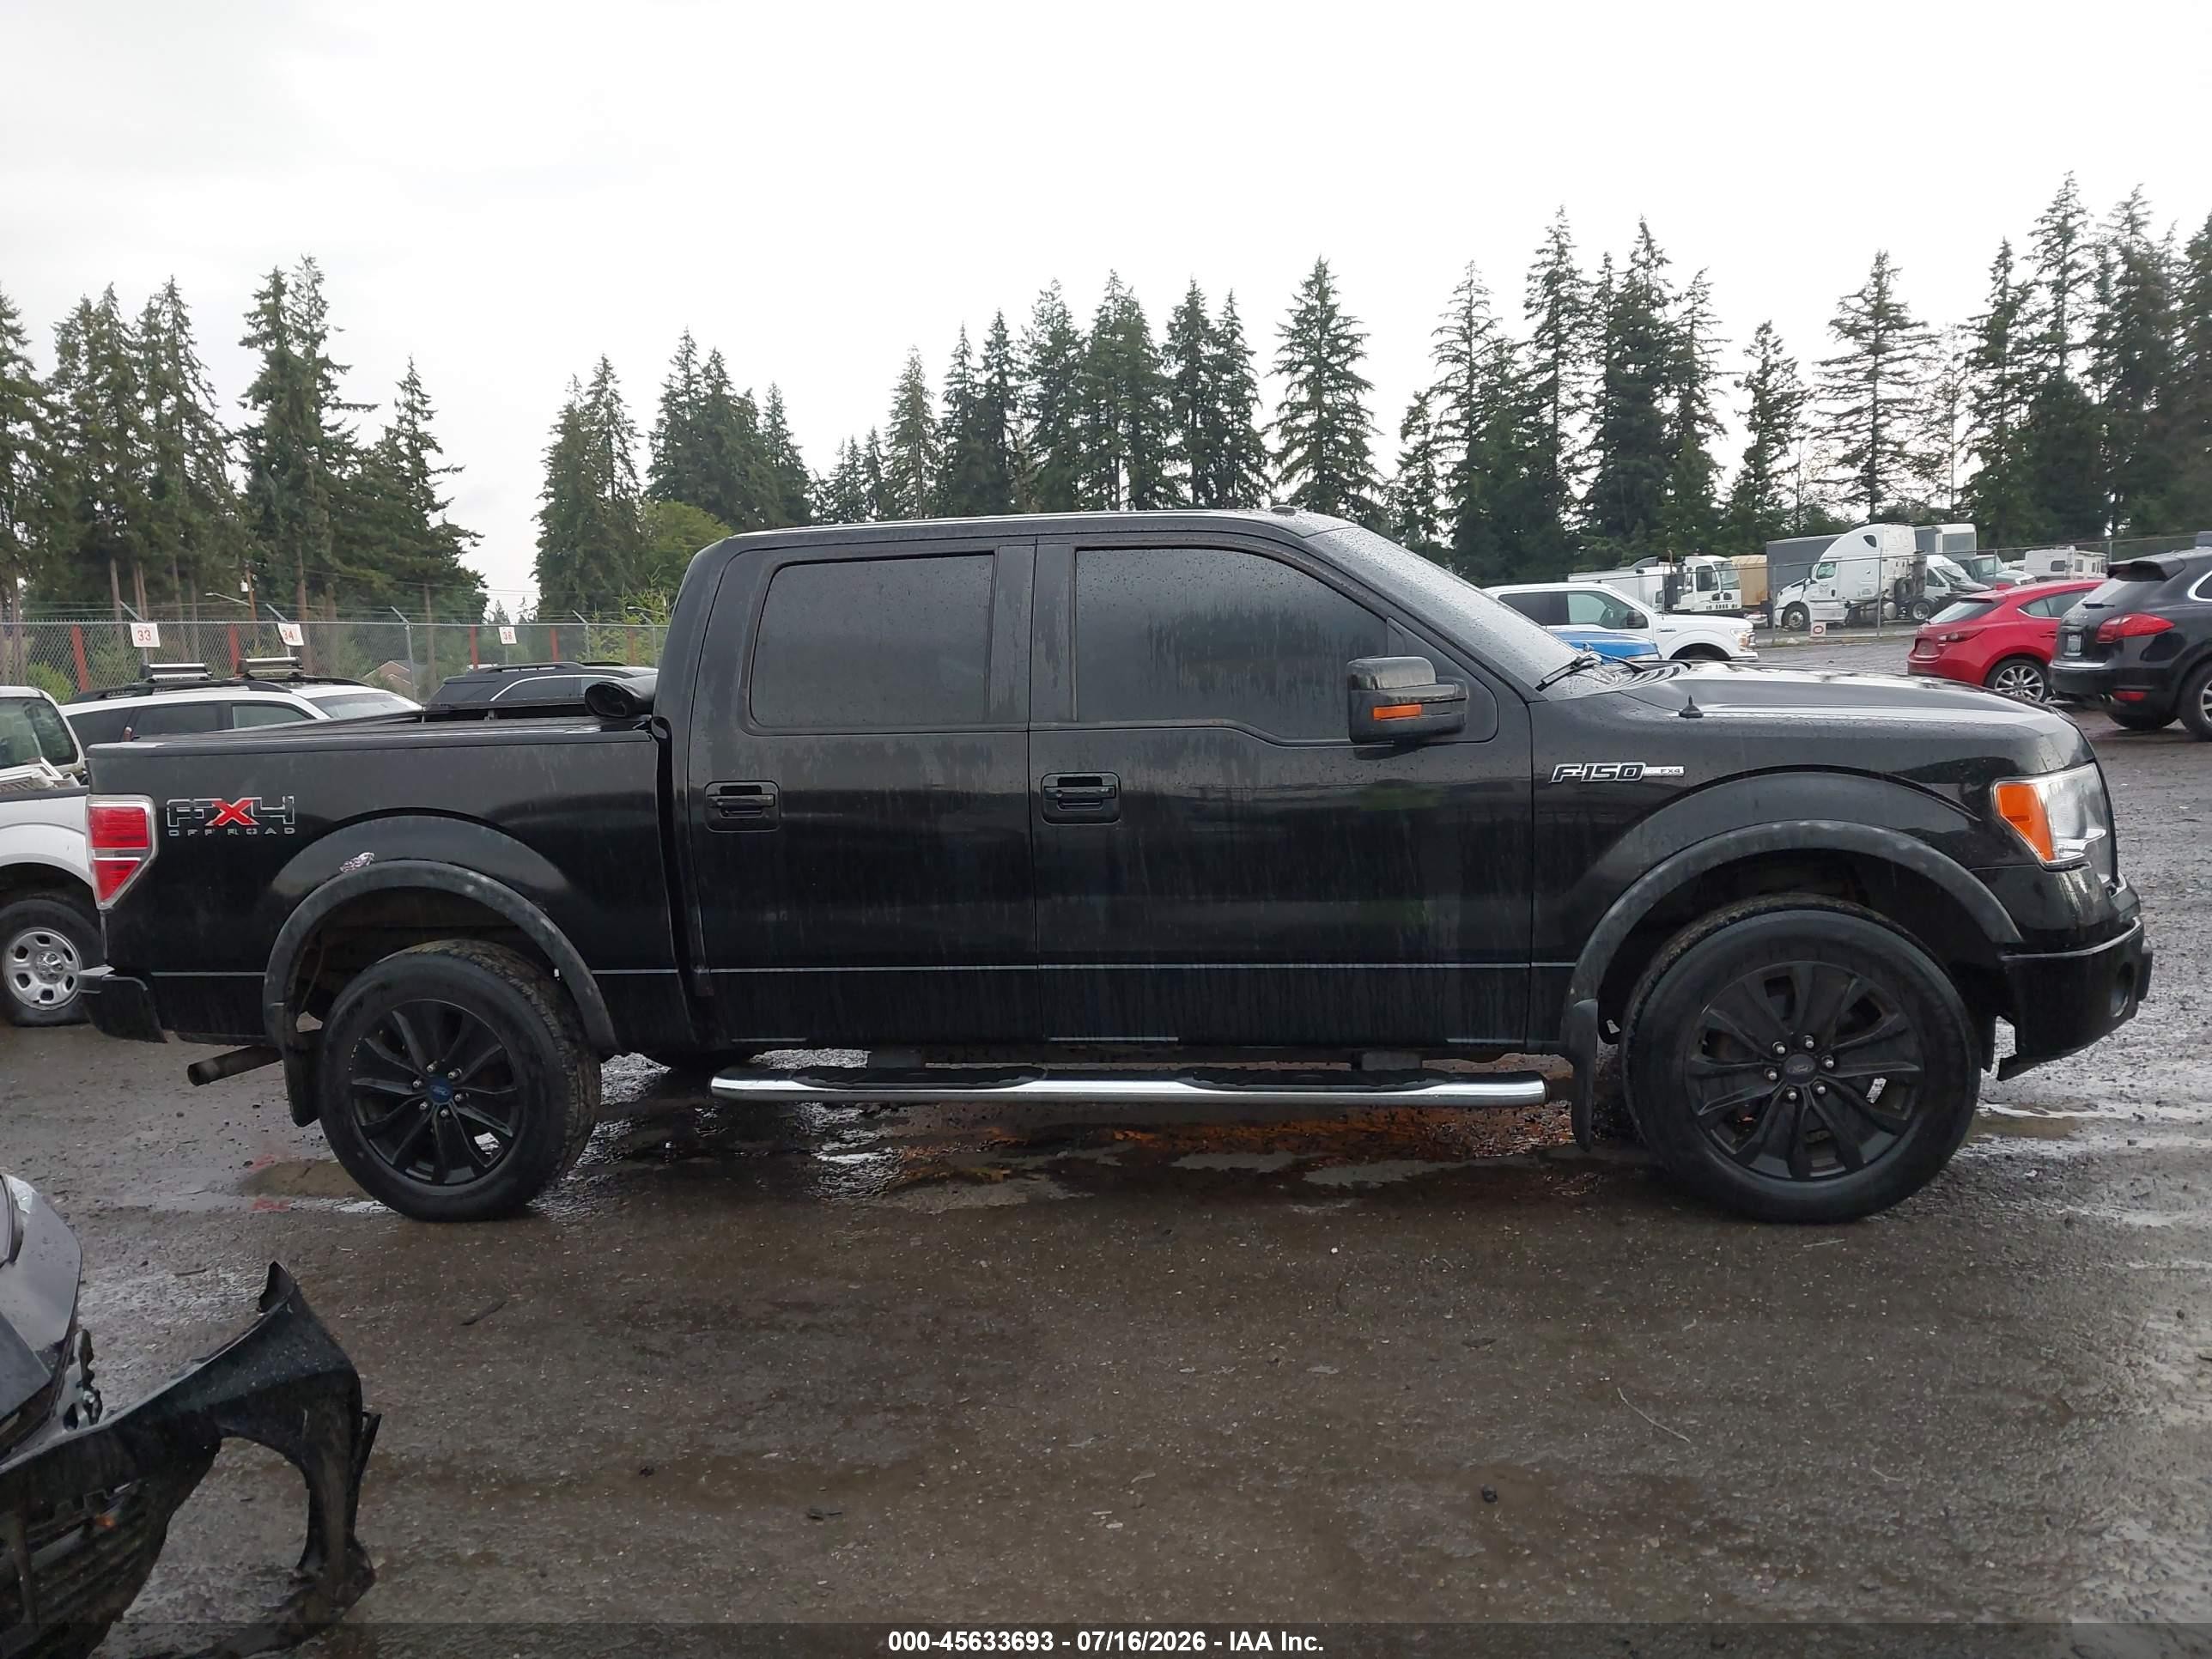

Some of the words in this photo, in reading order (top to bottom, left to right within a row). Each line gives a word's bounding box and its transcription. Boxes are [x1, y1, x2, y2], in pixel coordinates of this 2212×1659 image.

[137, 629, 152, 641] 33
[282, 629, 295, 641] 34
[1550, 762, 1647, 783] F-150
[166, 795, 295, 828] FX4
[167, 829, 216, 837] OFF
[227, 827, 296, 836] ROAD
